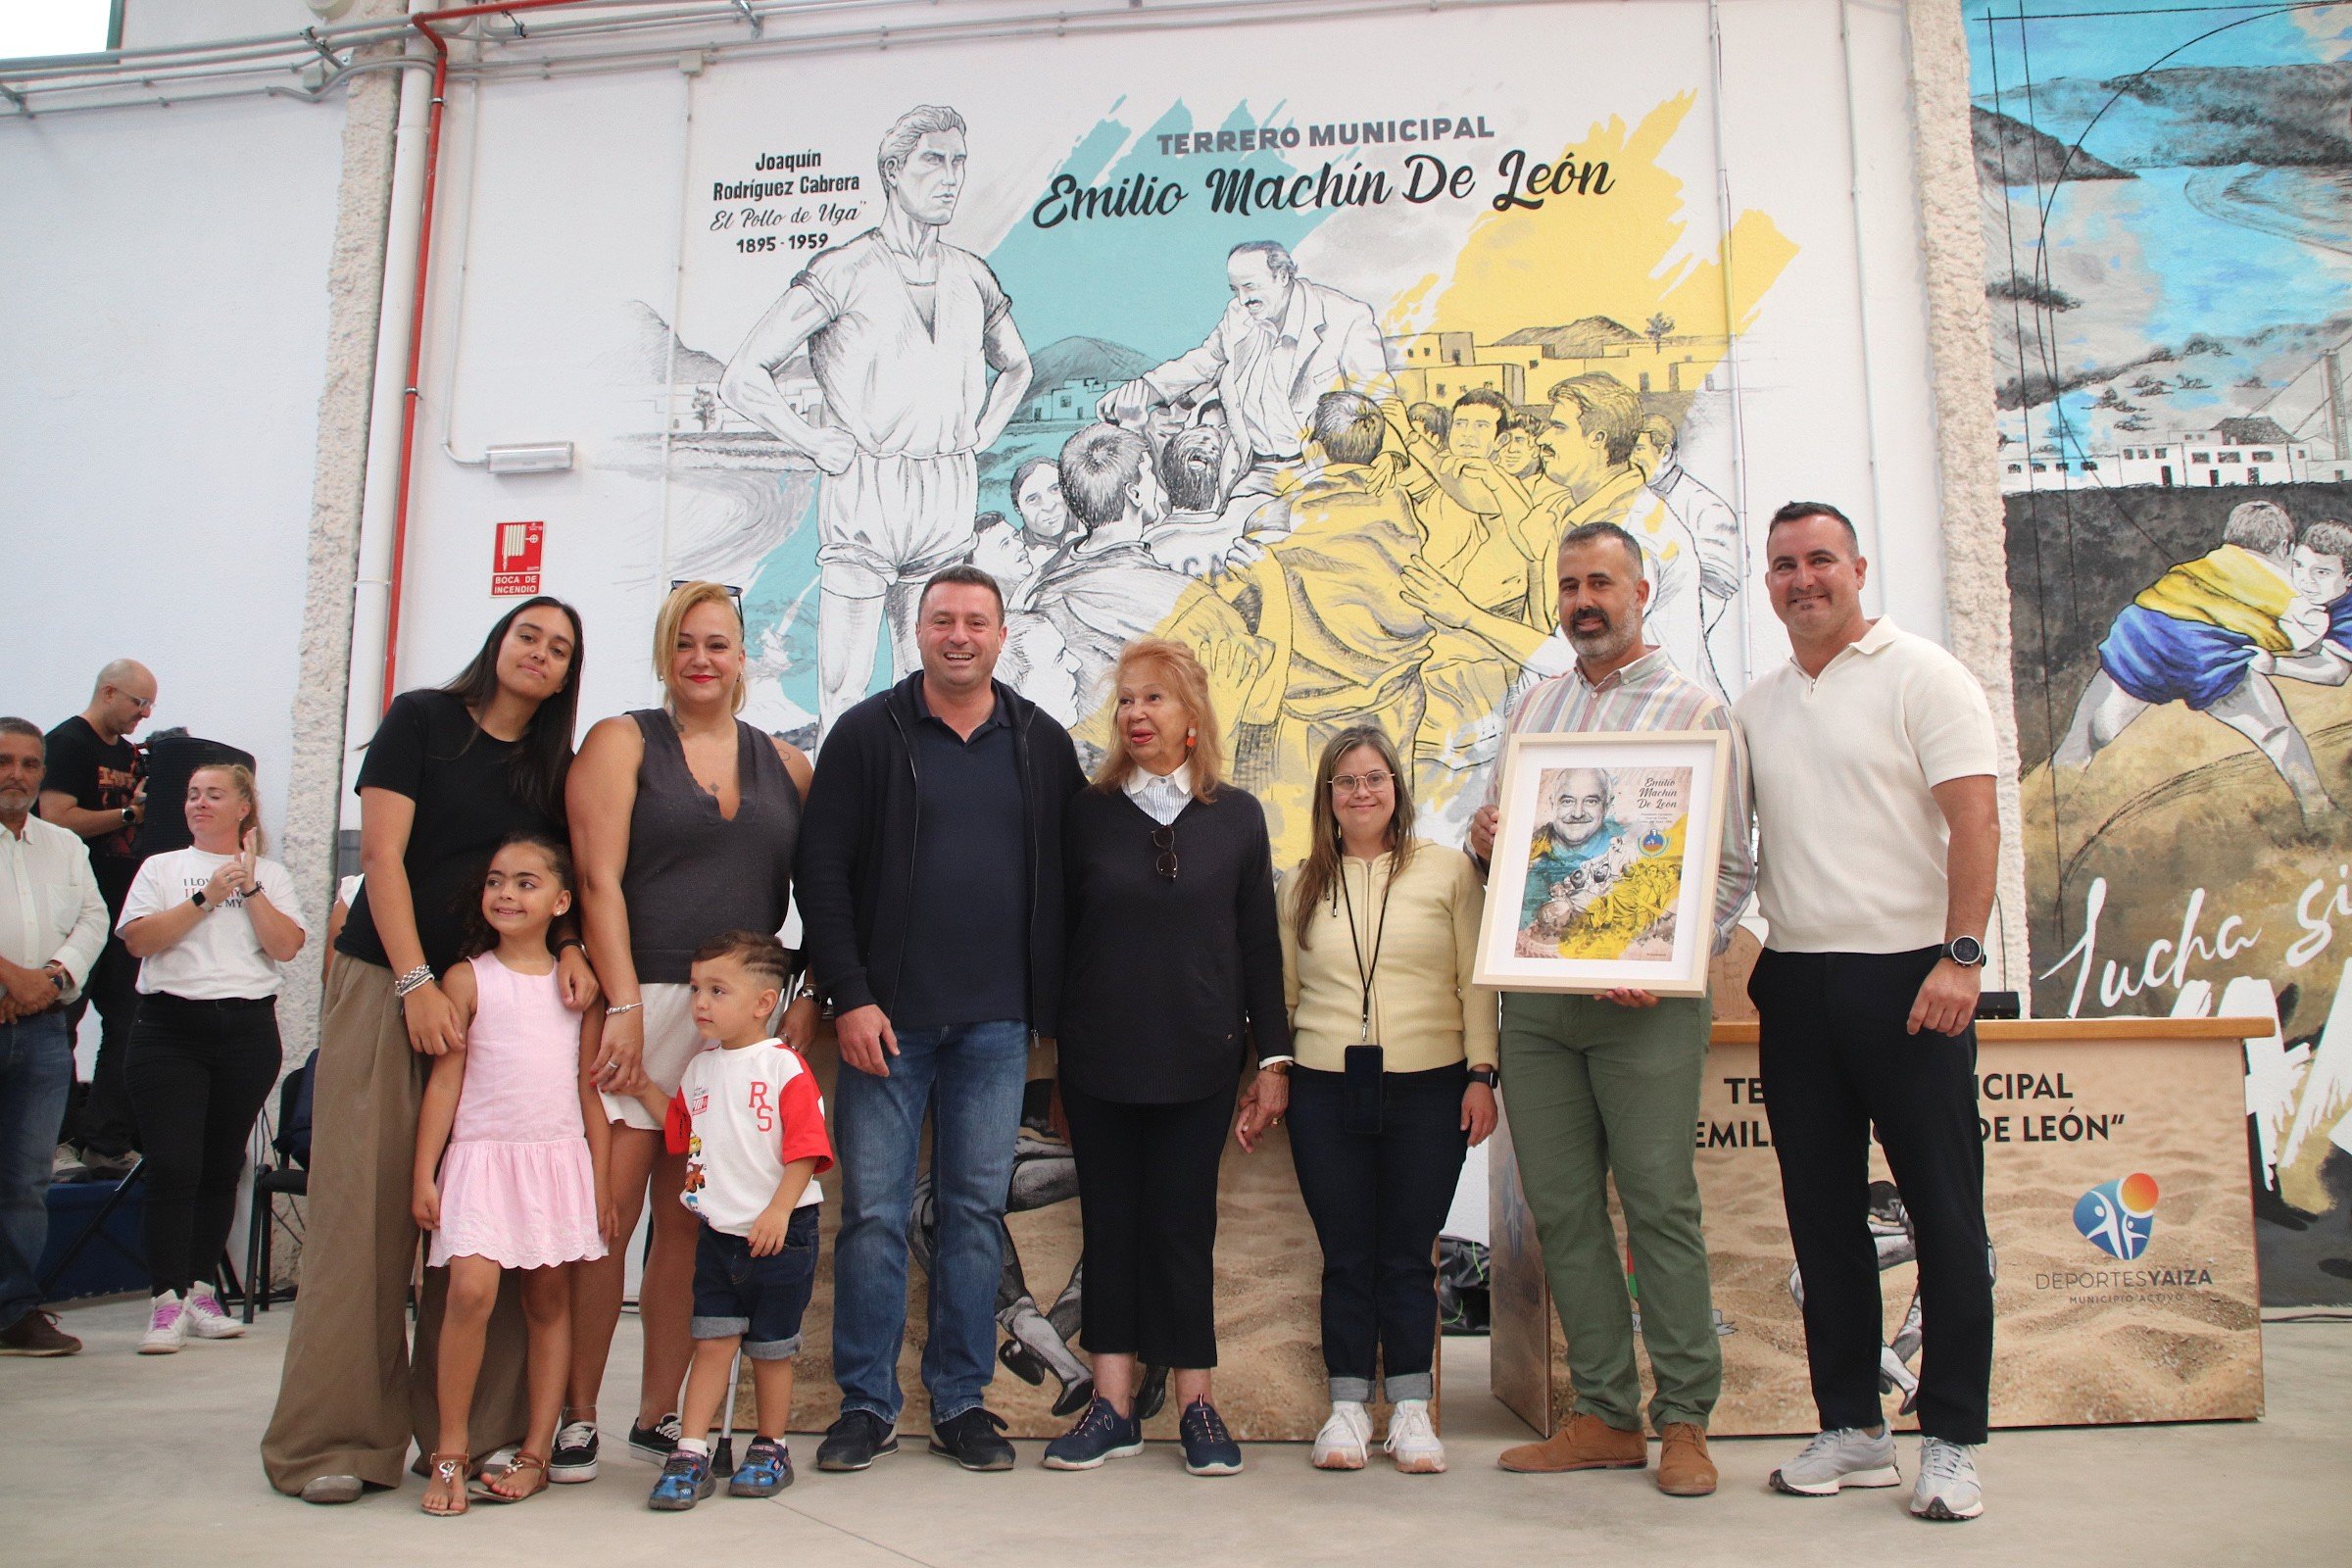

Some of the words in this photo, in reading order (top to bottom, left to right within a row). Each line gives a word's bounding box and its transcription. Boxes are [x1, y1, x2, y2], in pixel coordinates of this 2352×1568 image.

[1156, 127, 1300, 155] TERRERO
[1309, 116, 1494, 147] MUNICIPAL
[755, 149, 821, 172] Joaquín
[712, 178, 794, 202] Rodríguez
[800, 173, 859, 194] Cabrera
[1032, 172, 1189, 229] Emilio
[1204, 160, 1394, 217] Machín
[1401, 153, 1476, 204] De
[1492, 148, 1616, 212] León
[710, 210, 734, 231] El
[740, 207, 785, 228] Pollo
[790, 206, 811, 224] de
[736, 235, 776, 253] 1895
[788, 232, 829, 250] 1959
[494, 585, 536, 594] INCENDIO
[1644, 777, 1676, 788] Emilio
[1637, 798, 1652, 809] De
[748, 1081, 767, 1108] R
[756, 1104, 774, 1132] S
[2069, 1295, 2134, 1304] MUNICIPIO
[2139, 1293, 2184, 1303] ACTIVO
